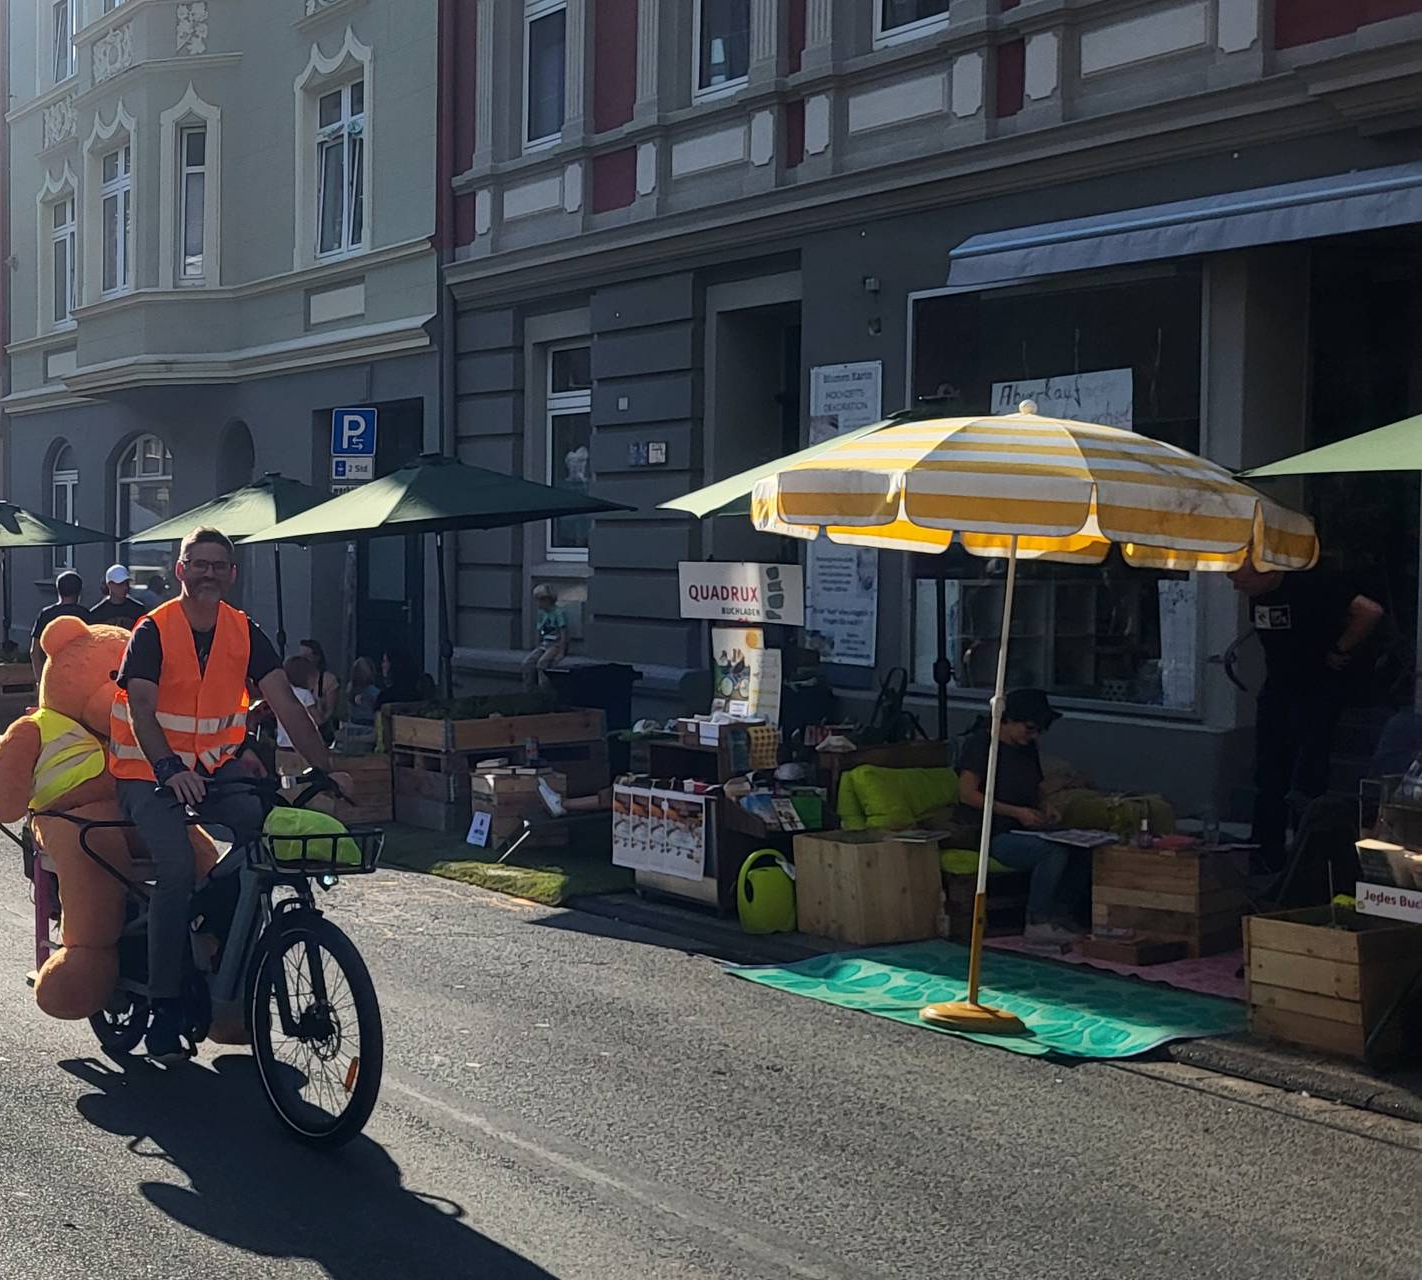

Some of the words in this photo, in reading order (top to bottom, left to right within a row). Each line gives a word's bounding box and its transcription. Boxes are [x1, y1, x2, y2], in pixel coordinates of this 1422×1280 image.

[342, 415, 366, 449] P
[688, 584, 760, 603] QUADRUX
[721, 606, 761, 617] BUCHLADEN
[1363, 889, 1398, 906] Jedes
